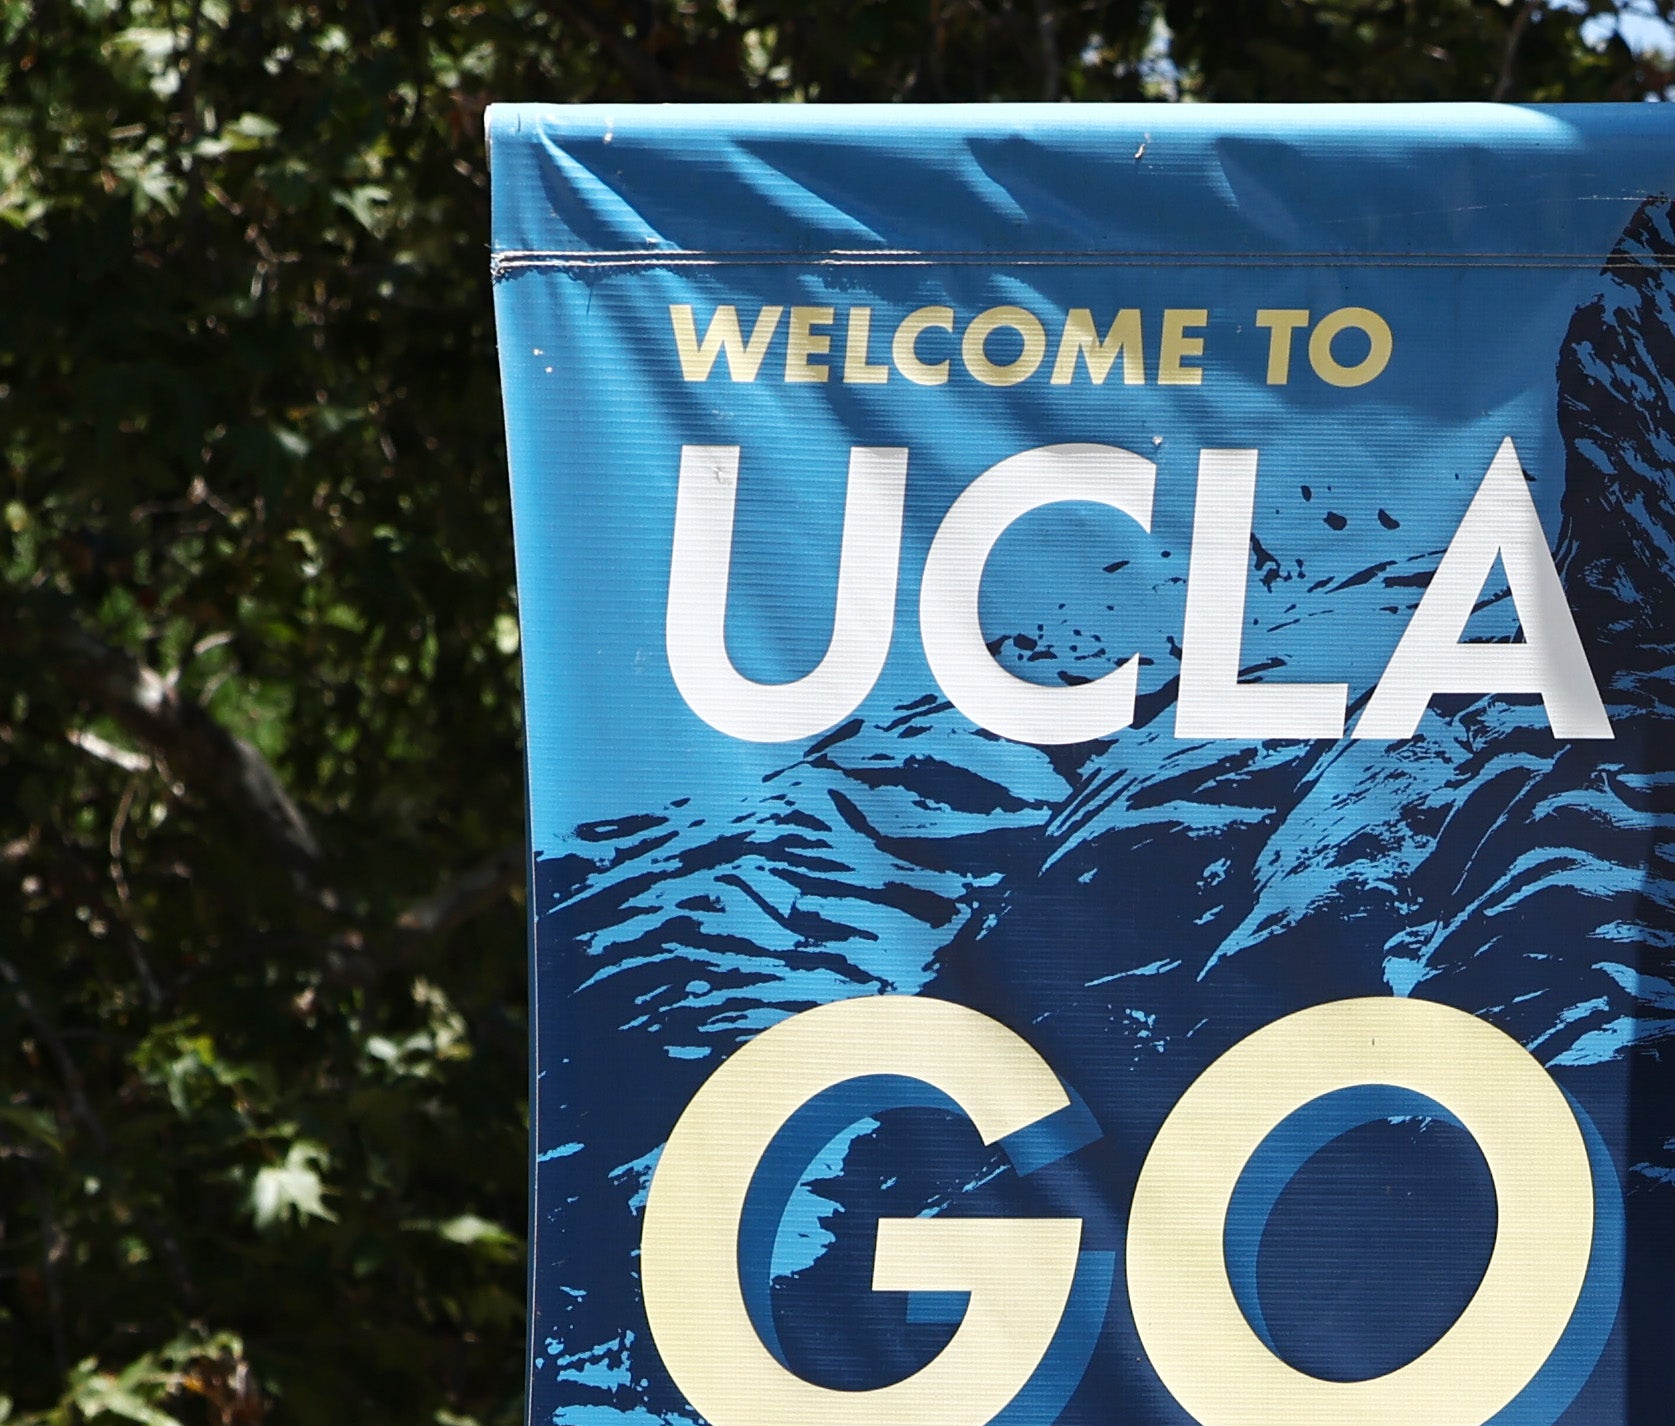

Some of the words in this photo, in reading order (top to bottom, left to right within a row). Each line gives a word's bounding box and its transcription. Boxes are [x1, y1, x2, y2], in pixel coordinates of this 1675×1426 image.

[669, 304, 1209, 387] WELCOME
[1254, 307, 1394, 388] TO
[665, 436, 1615, 744] UCLA
